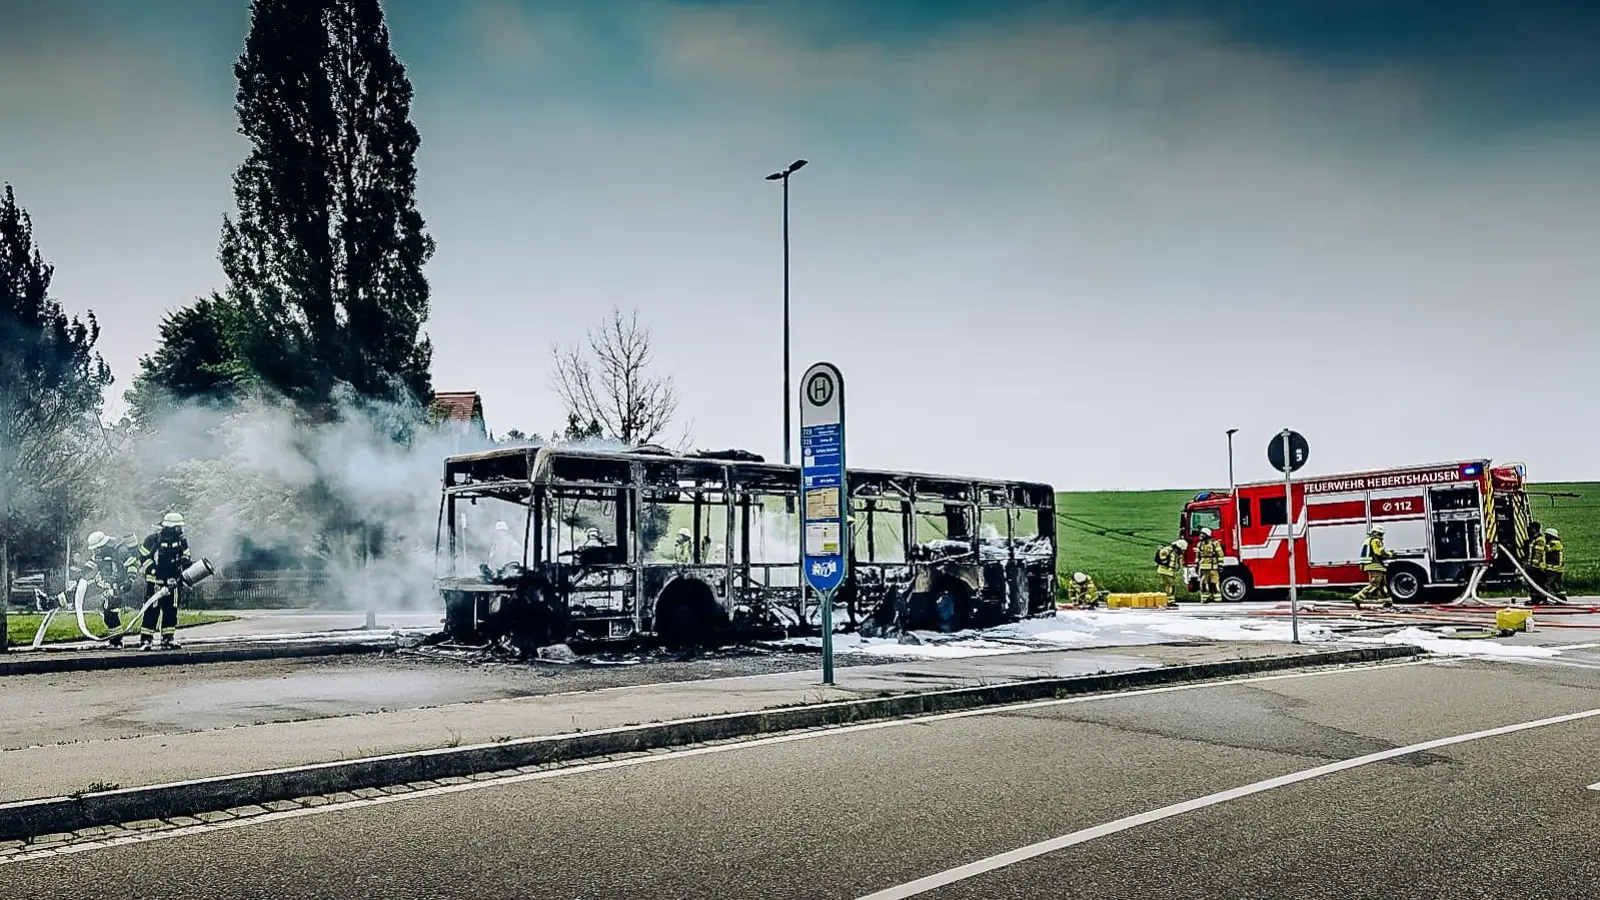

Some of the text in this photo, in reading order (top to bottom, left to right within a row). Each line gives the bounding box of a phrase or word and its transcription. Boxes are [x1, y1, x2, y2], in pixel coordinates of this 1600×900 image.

[814, 379, 826, 400] H
[1303, 470, 1460, 493] FEUERWEHR HEBERTSHAUSEN
[1394, 501, 1413, 511] 112
